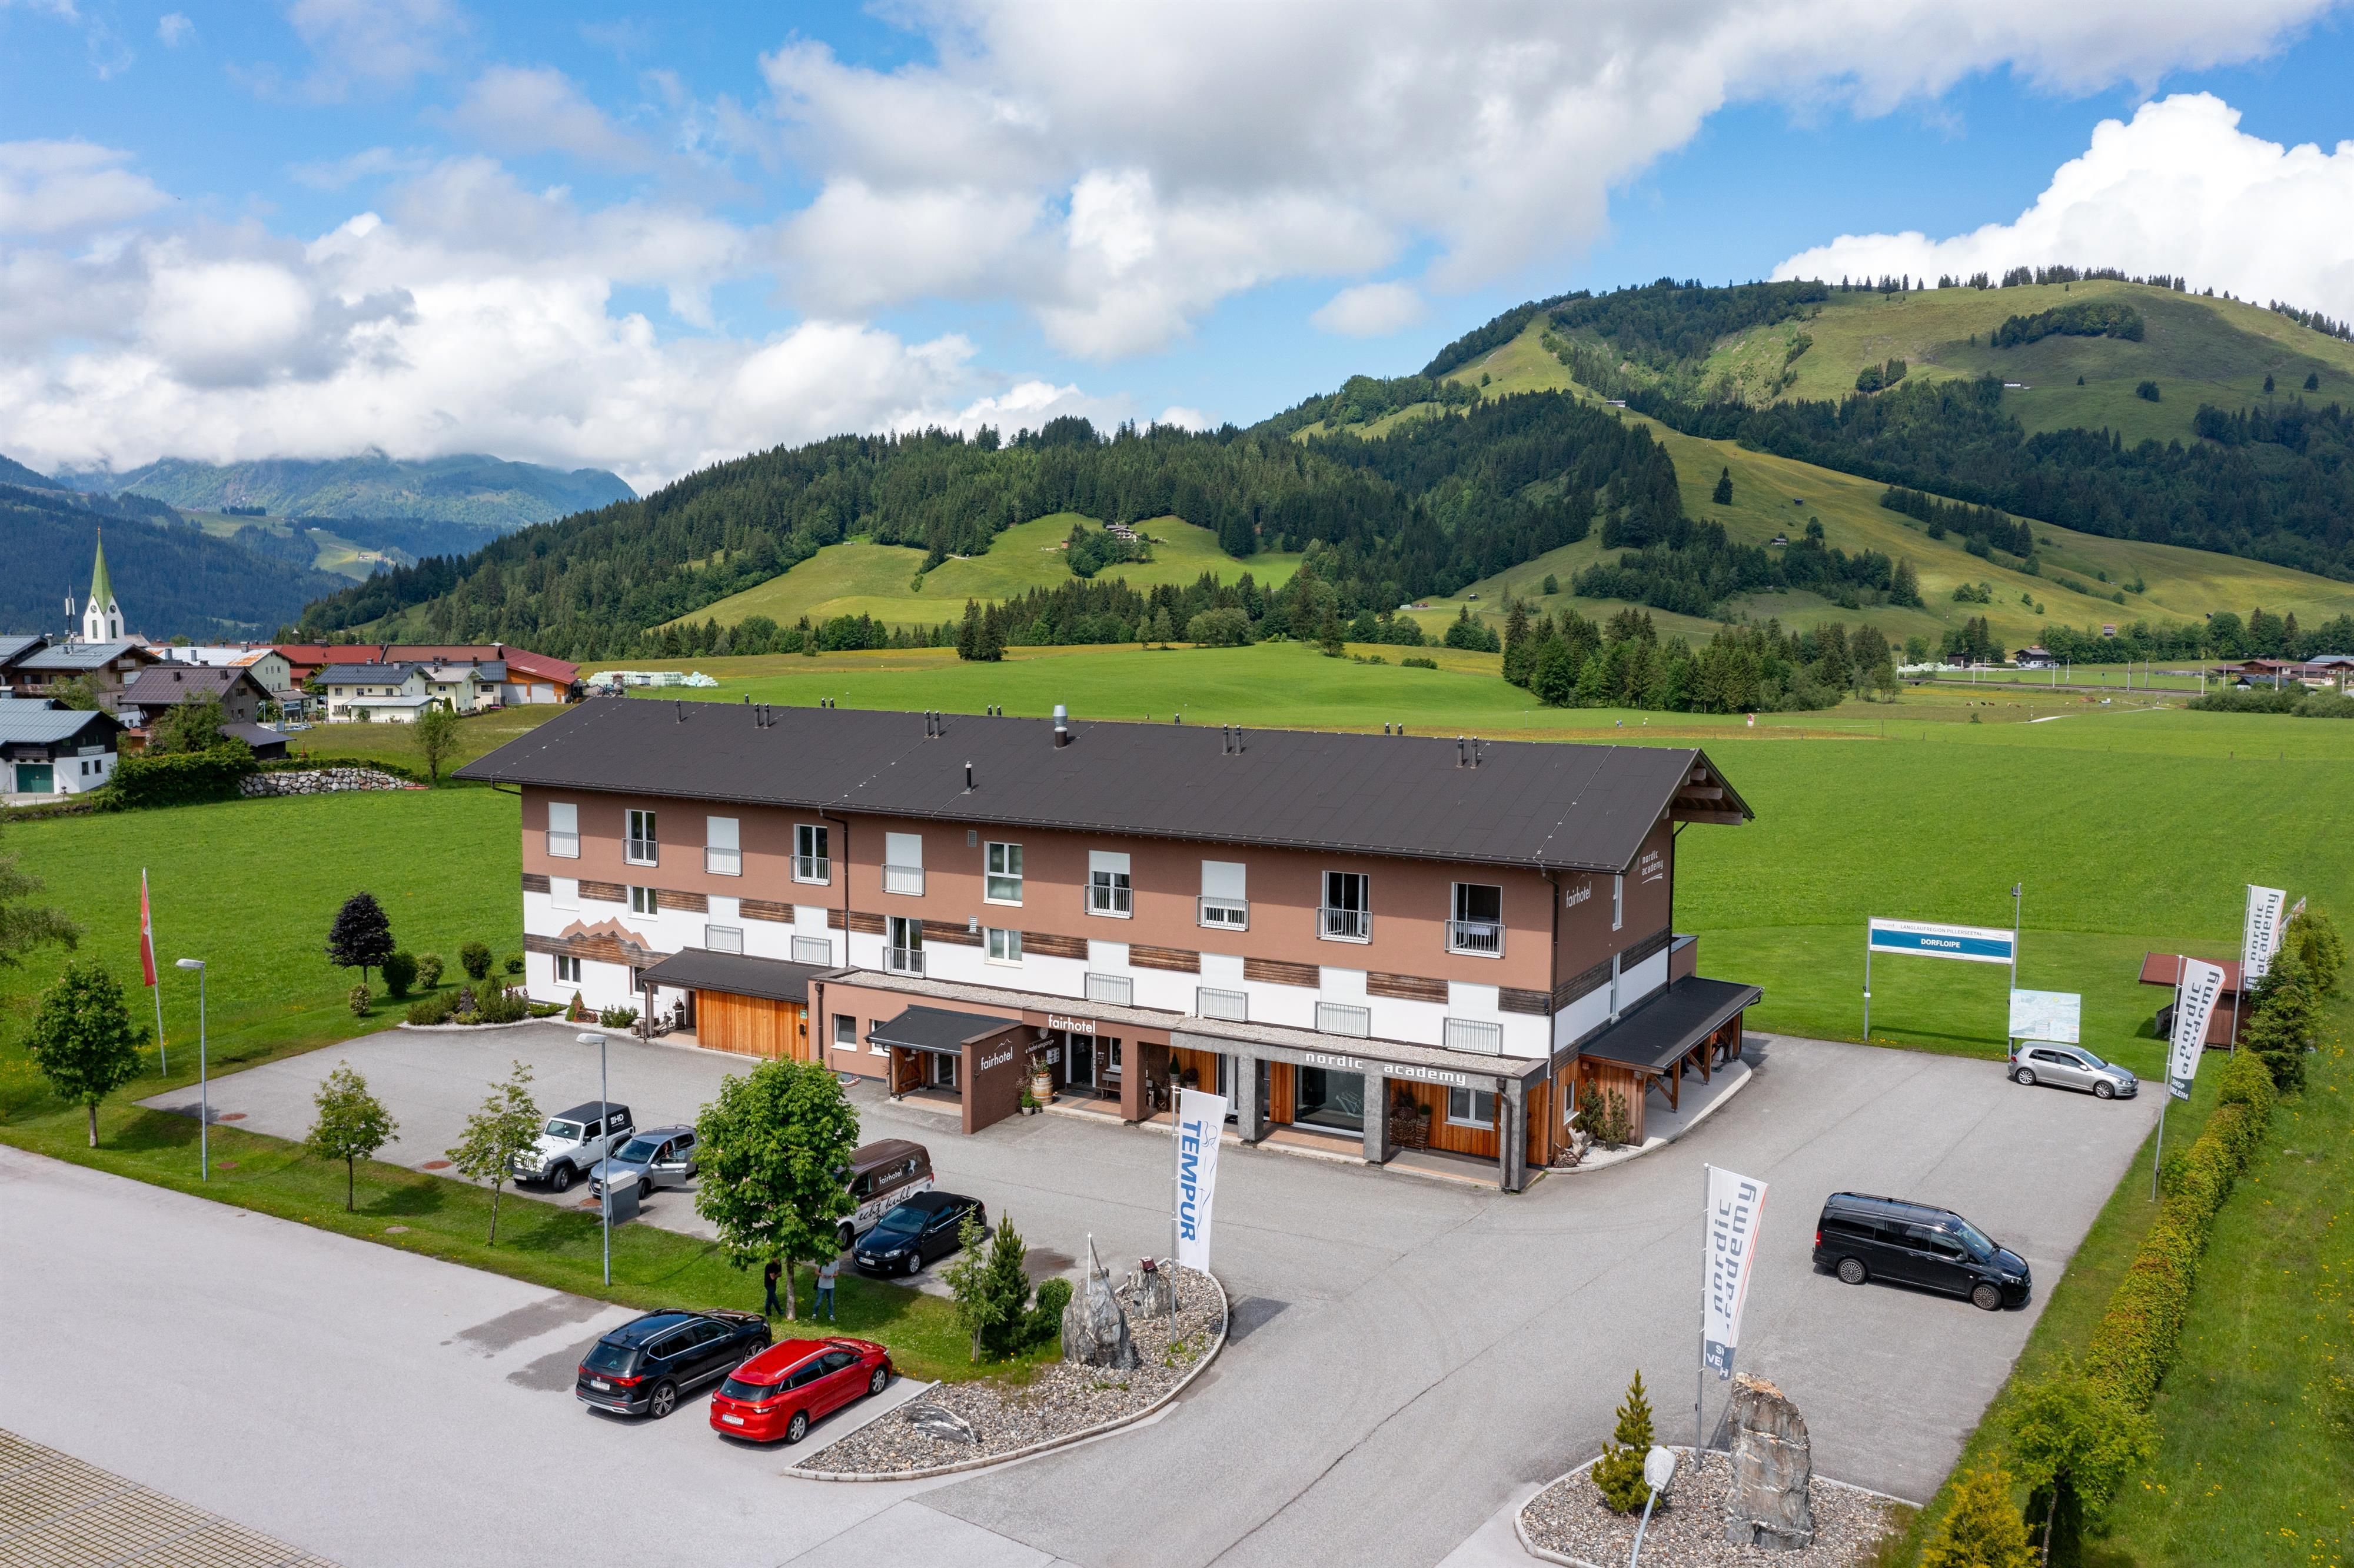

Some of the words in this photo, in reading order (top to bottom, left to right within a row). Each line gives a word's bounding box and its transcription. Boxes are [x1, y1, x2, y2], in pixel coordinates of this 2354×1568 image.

[1642, 860, 1663, 875] academy
[1643, 850, 1658, 864] nordic
[1566, 880, 1591, 908] fairhotel
[1900, 924, 1946, 933] LANGLAUFREGION
[2250, 903, 2264, 961] nordic
[2256, 893, 2279, 973] academy
[1921, 938, 1961, 948] DORFLOIPE
[1048, 1014, 1096, 1033] fairhotel
[2179, 982, 2202, 1057] nordic
[980, 1046, 1013, 1071] fairhotel
[1305, 1053, 1364, 1070] nordic
[1384, 1063, 1467, 1086] academy
[879, 1168, 902, 1184] fairhotel
[1181, 1120, 1202, 1241] TEMPUR
[1714, 1199, 1731, 1314] nordic
[1725, 1182, 1757, 1333] cademy
